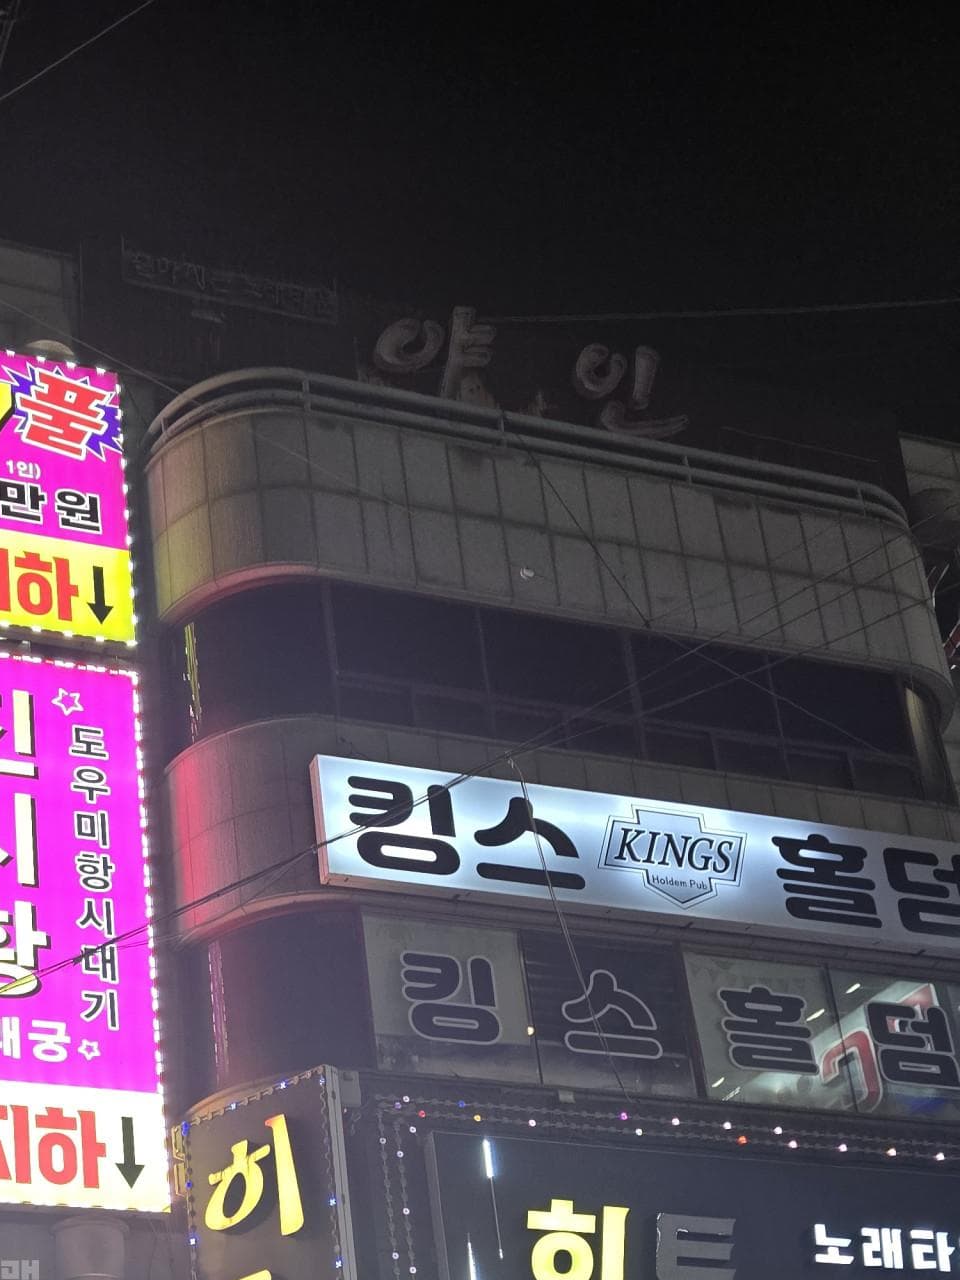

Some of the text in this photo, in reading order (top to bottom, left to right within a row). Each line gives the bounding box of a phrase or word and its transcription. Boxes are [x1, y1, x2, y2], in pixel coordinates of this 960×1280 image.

[15, 367, 115, 461] 풀
[347, 774, 585, 890] 킹스
[614, 828, 733, 873] KINGS
[651, 875, 708, 890] Holdem Pub
[399, 950, 664, 1060] 킹스
[814, 1223, 960, 1272] 노래타
